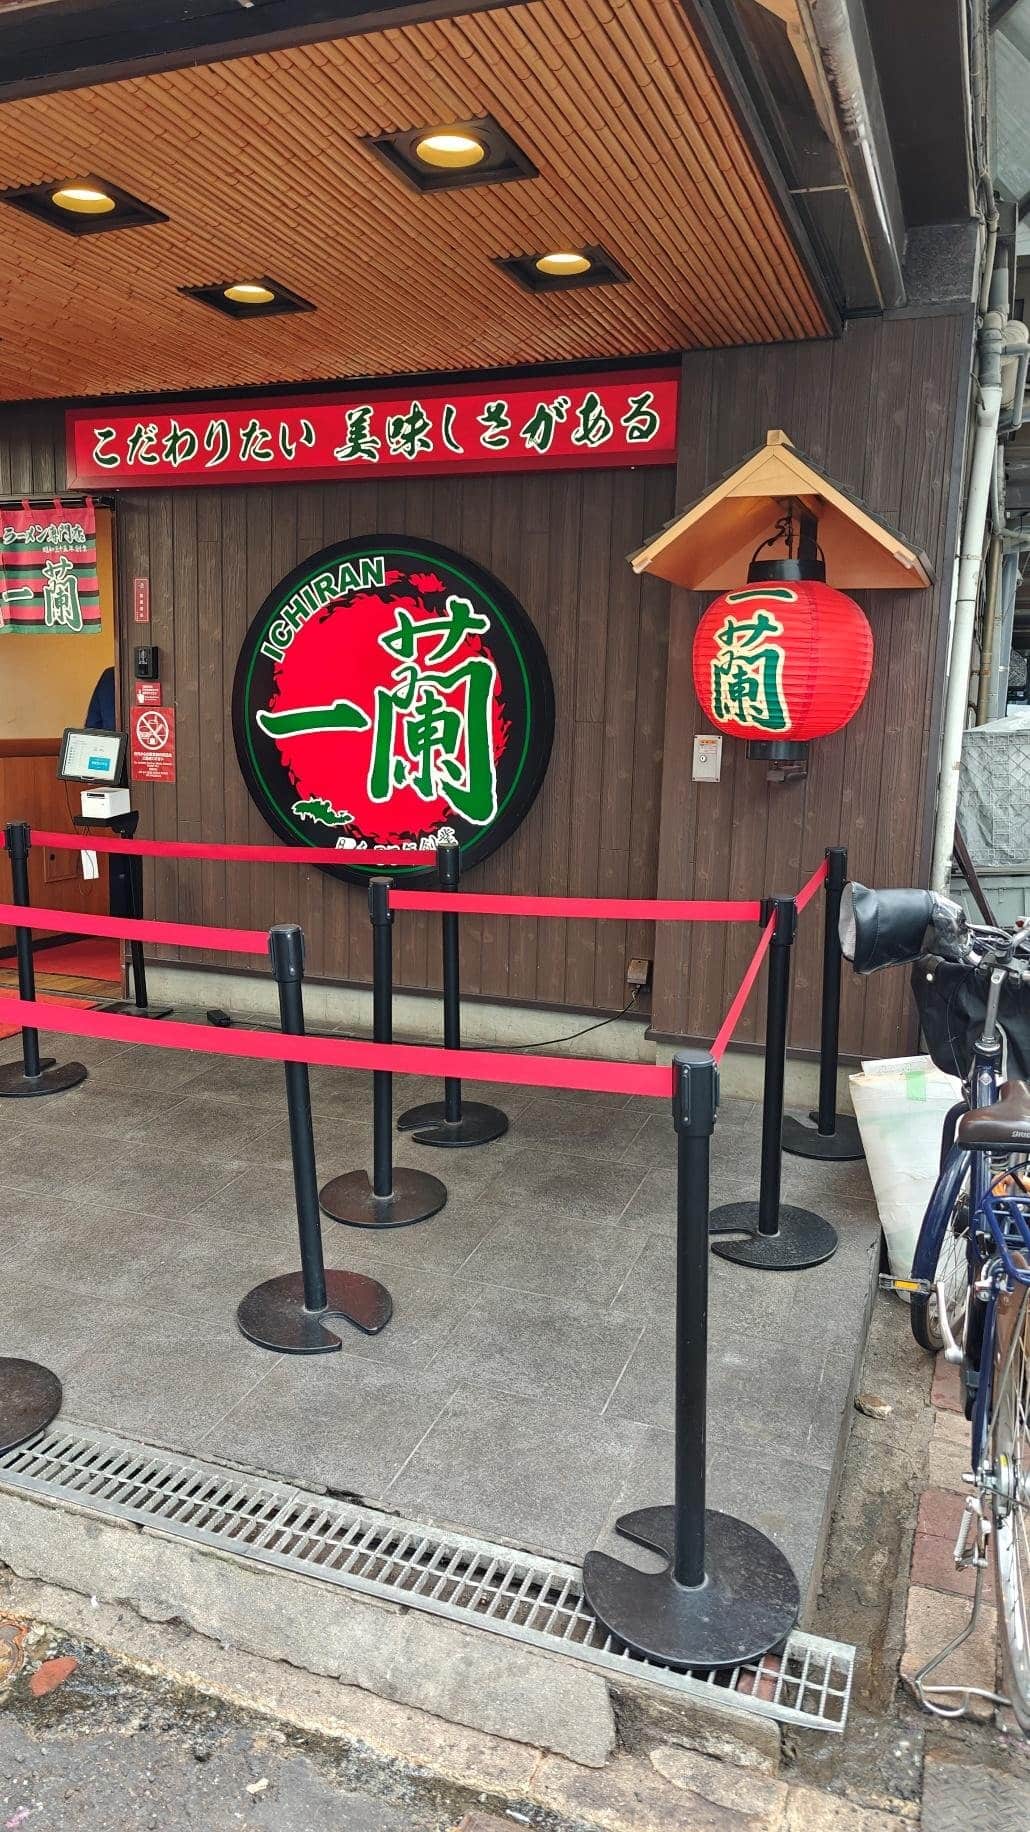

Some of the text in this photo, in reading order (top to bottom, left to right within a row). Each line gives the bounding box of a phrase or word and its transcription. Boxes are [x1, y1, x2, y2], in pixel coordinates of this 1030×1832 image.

[92, 391, 660, 469] こだわりたい 美味しさがある
[2, 522, 86, 545] ラーメン専門店
[2, 555, 84, 632] 一蘭
[261, 557, 386, 663] ICHIRAN
[710, 587, 797, 732] 一蘭
[256, 595, 498, 825] 一蘭
